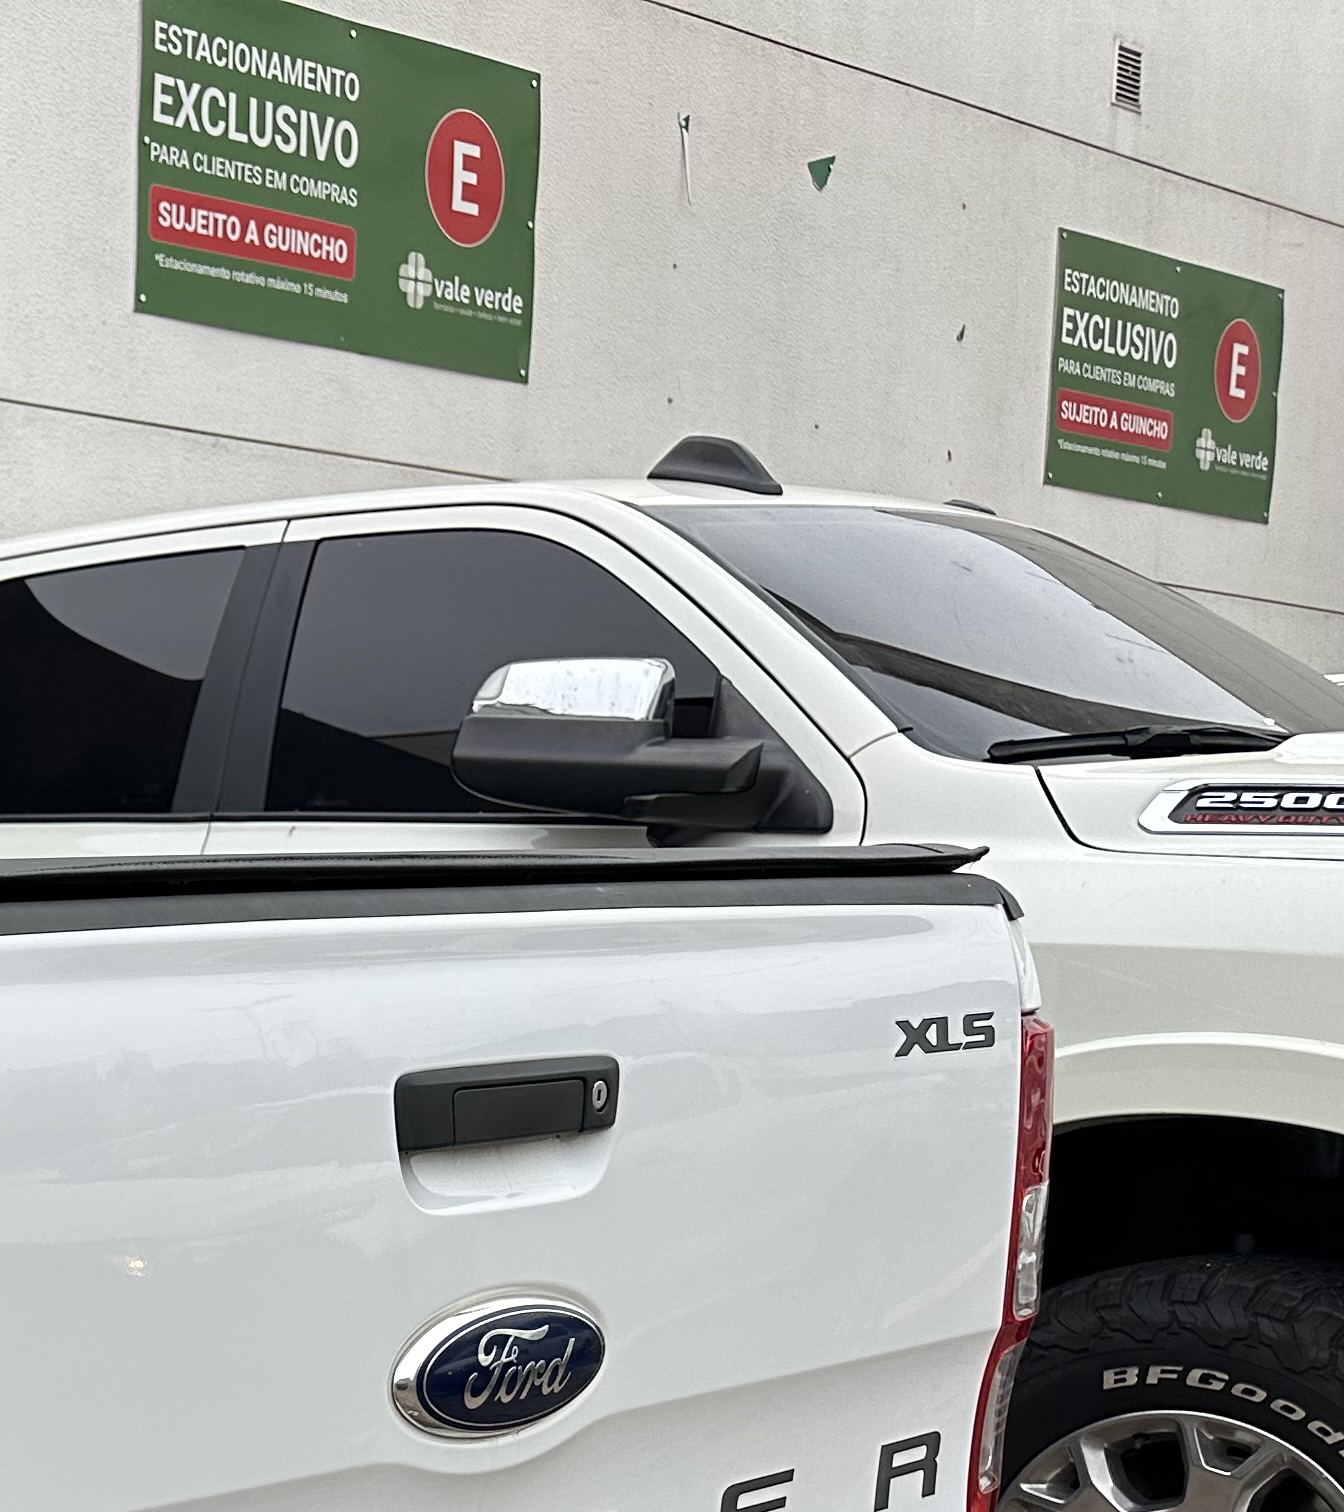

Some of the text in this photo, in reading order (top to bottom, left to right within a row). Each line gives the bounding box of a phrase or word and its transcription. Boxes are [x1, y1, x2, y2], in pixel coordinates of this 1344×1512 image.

[154, 19, 360, 102] ESTACIONAMENTO
[152, 72, 360, 169] EXCLUSIVO
[150, 142, 358, 207] PARA CLIENTES EM COMPRAS
[451, 140, 481, 217] E
[158, 201, 348, 264] SUJEITO A GUINCHO
[434, 275, 471, 304] vale
[474, 286, 523, 315] verde
[1064, 268, 1179, 319] ESTACIONAMENTO
[1061, 306, 1177, 369] EXCLUSIVO
[1058, 357, 1175, 397] PARA CLIENTES EM COMPRAS
[1229, 342, 1249, 399] E
[1060, 400, 1168, 440] SUJEITO A GUINCHO
[1215, 444, 1269, 471] vale verde
[1183, 813, 1277, 824] HEAVY
[894, 1011, 995, 1058] XLS
[464, 1324, 576, 1410] Ford
[1102, 1365, 1344, 1458] BFGood
